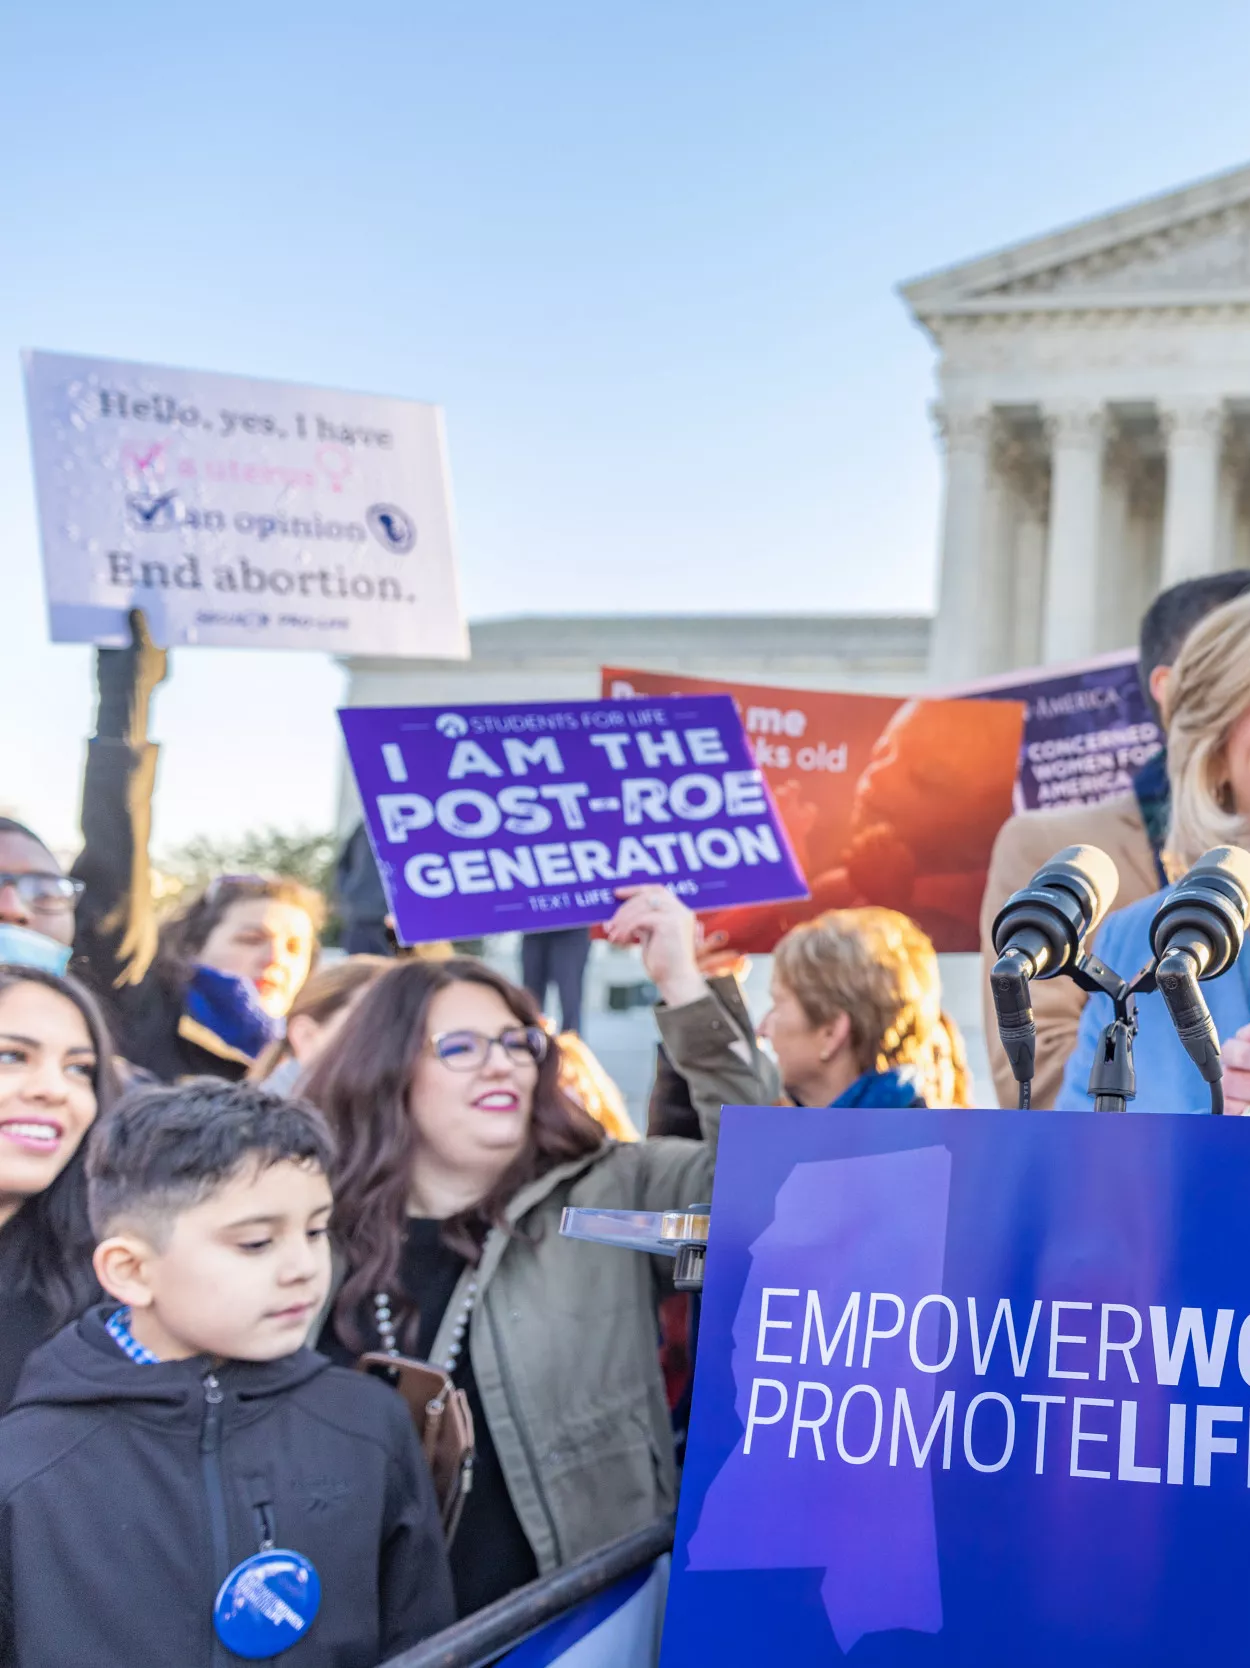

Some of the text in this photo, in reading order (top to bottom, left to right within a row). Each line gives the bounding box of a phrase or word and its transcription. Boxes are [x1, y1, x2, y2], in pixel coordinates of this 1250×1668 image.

[99, 388, 395, 450] Hello, yes, I have
[232, 506, 368, 543] opinion
[106, 550, 416, 604] End abortion.
[470, 708, 667, 735] STUDENTS FOR LIFE
[380, 728, 730, 782] I AM THE
[796, 741, 849, 772] old
[1027, 721, 1159, 763] CONCERNED
[1031, 751, 1116, 783] WOMEN
[1037, 769, 1133, 803] AMERICA
[376, 769, 767, 843] POST-ROE
[403, 824, 782, 898] GENERATION
[528, 892, 572, 912] TEXT
[574, 887, 616, 908] LIFE
